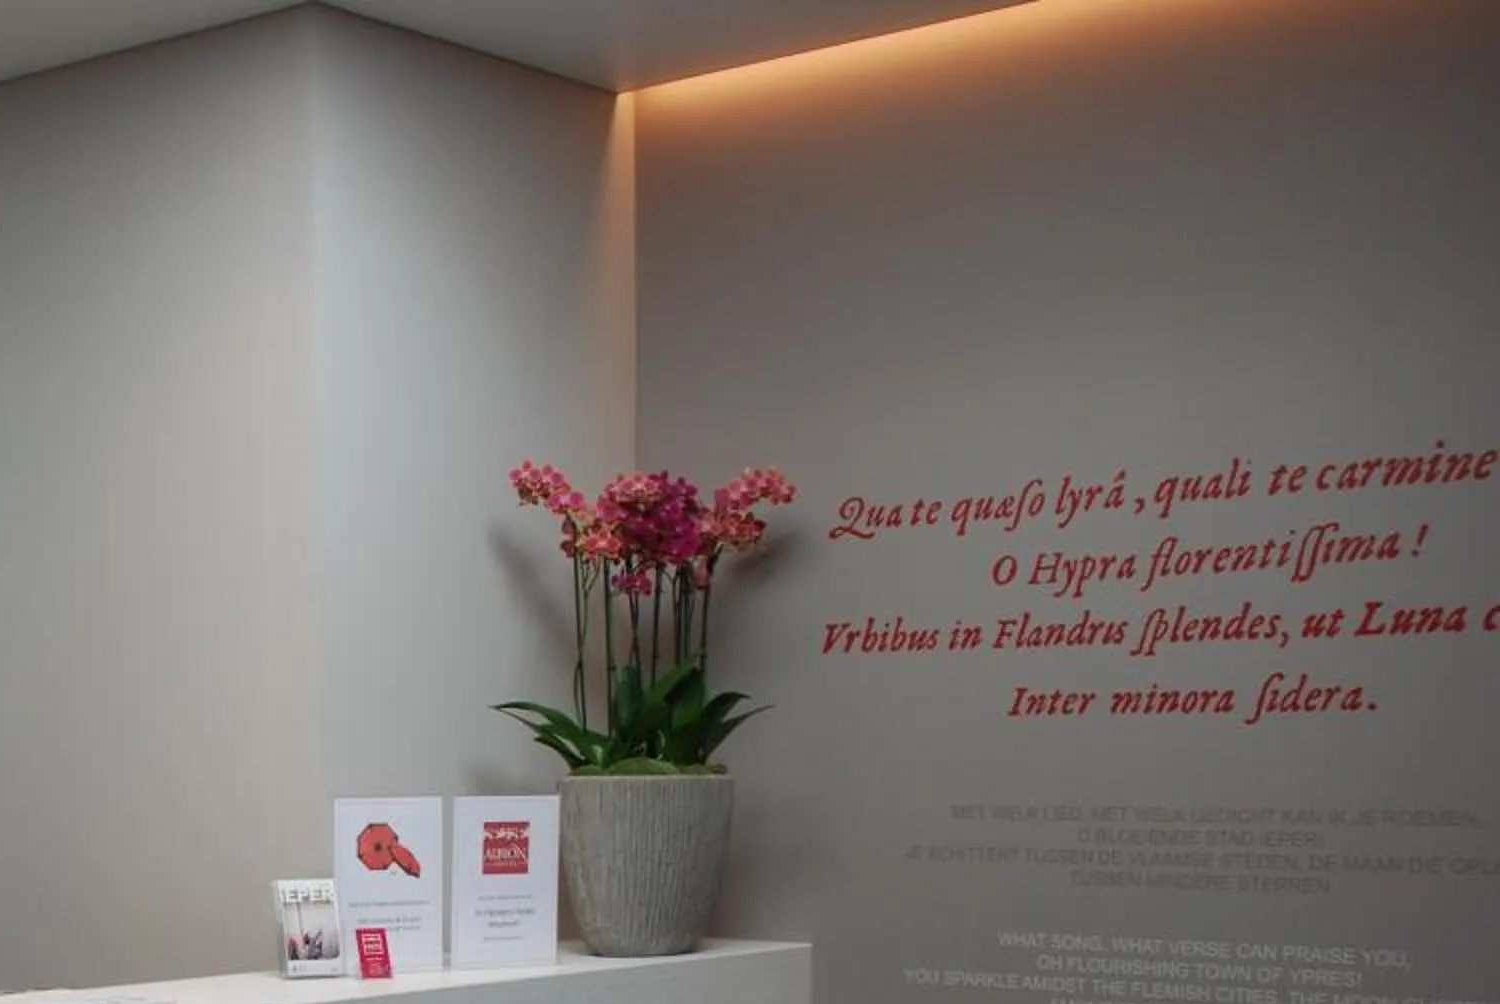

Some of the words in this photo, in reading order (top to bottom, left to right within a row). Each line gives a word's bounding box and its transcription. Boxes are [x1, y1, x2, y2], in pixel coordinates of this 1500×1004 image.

[1153, 457, 1252, 519] quali
[1267, 464, 1306, 497] te
[1315, 439, 1500, 492] carmine
[990, 555, 1019, 586] O
[1028, 552, 1136, 600] Hypra
[948, 621, 984, 651] in
[1300, 607, 1346, 639] ut
[1352, 600, 1469, 639] Luna
[1008, 687, 1096, 717] Inter
[1110, 683, 1236, 715] minora
[997, 931, 1046, 948] WHAT
[1110, 936, 1164, 954] WHAT
[1169, 939, 1233, 959] VERSE
[1236, 942, 1279, 962] CAN
[1282, 944, 1357, 966] PRAISE
[903, 966, 939, 986] YOU
[943, 969, 1019, 991] SPARKLE
[1092, 978, 1125, 996] THE
[1130, 981, 1211, 1002] FLEMISH
[1036, 952, 1063, 972] OH
[1066, 954, 1190, 978] FLOURISHING
[1192, 961, 1252, 981] TOWN
[1256, 965, 1285, 983] OF
